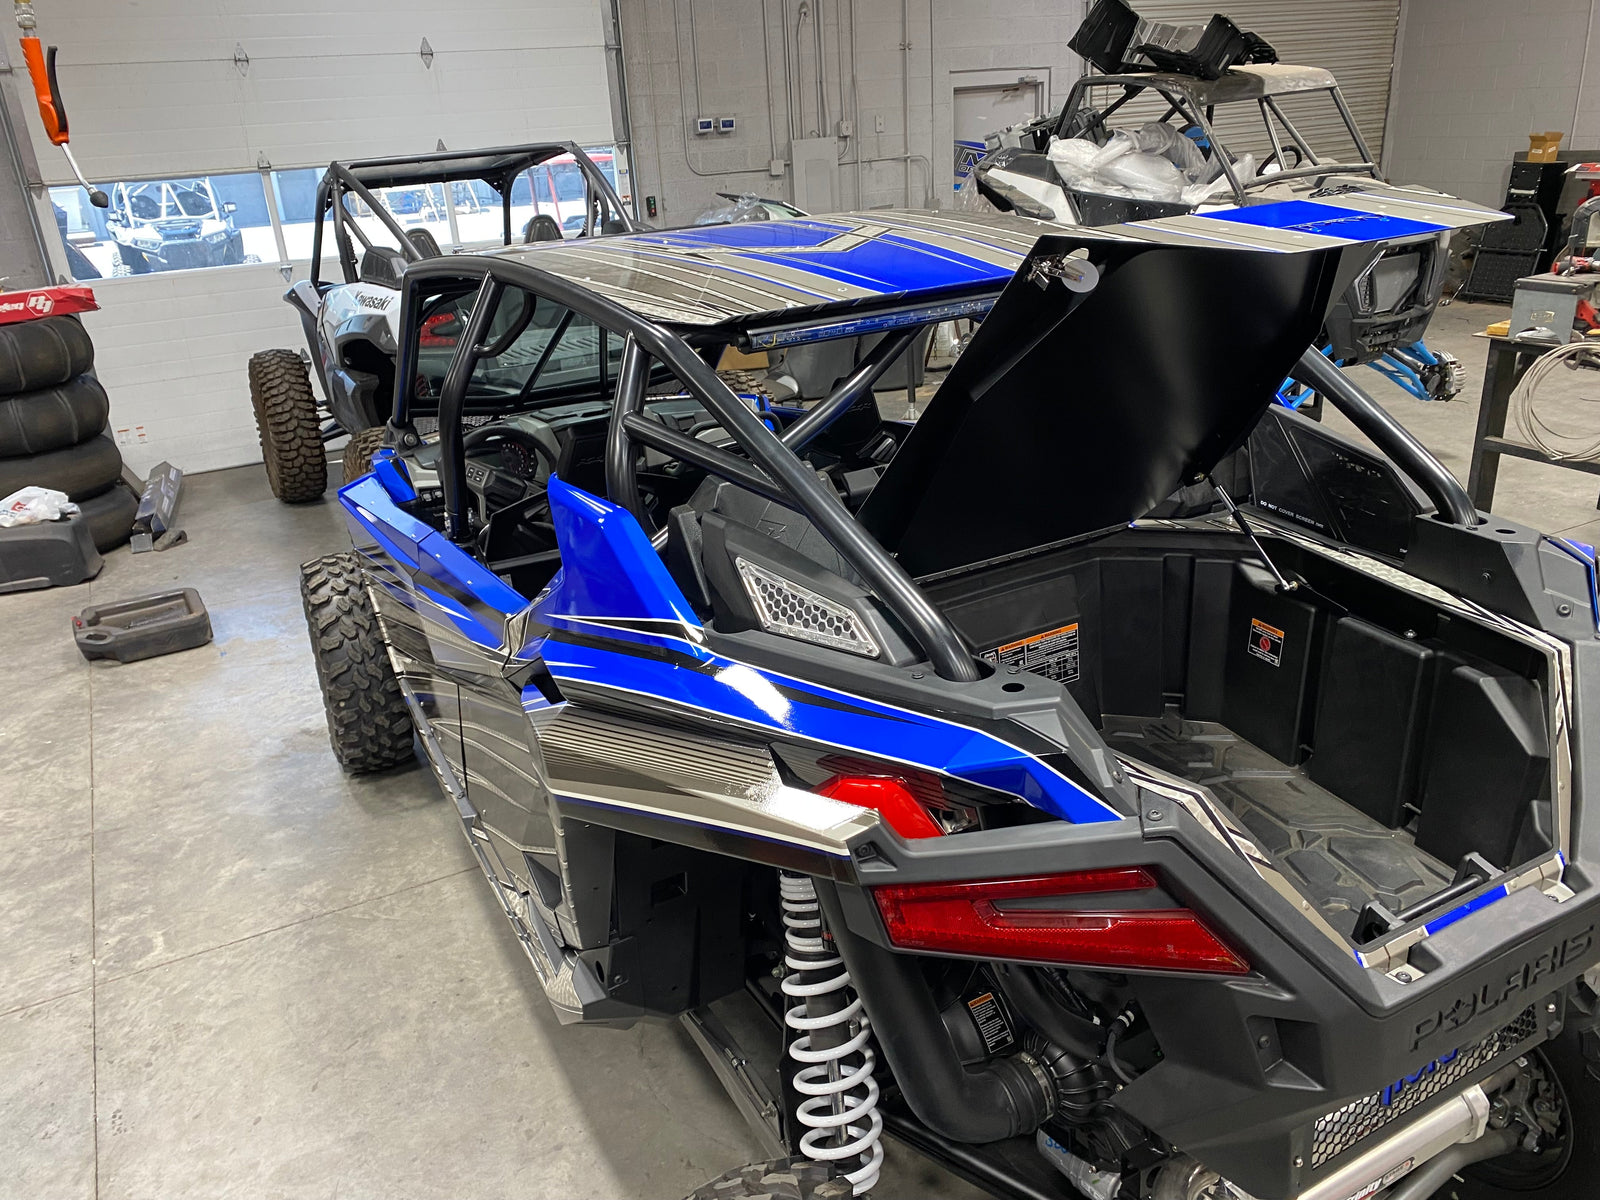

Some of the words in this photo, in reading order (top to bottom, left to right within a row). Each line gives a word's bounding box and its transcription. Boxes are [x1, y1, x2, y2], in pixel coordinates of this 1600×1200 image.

[355, 290, 394, 311] Kawasaki
[1268, 503, 1278, 511] NOT
[1279, 507, 1295, 517] COVER
[1409, 924, 1594, 1052] POLARIS
